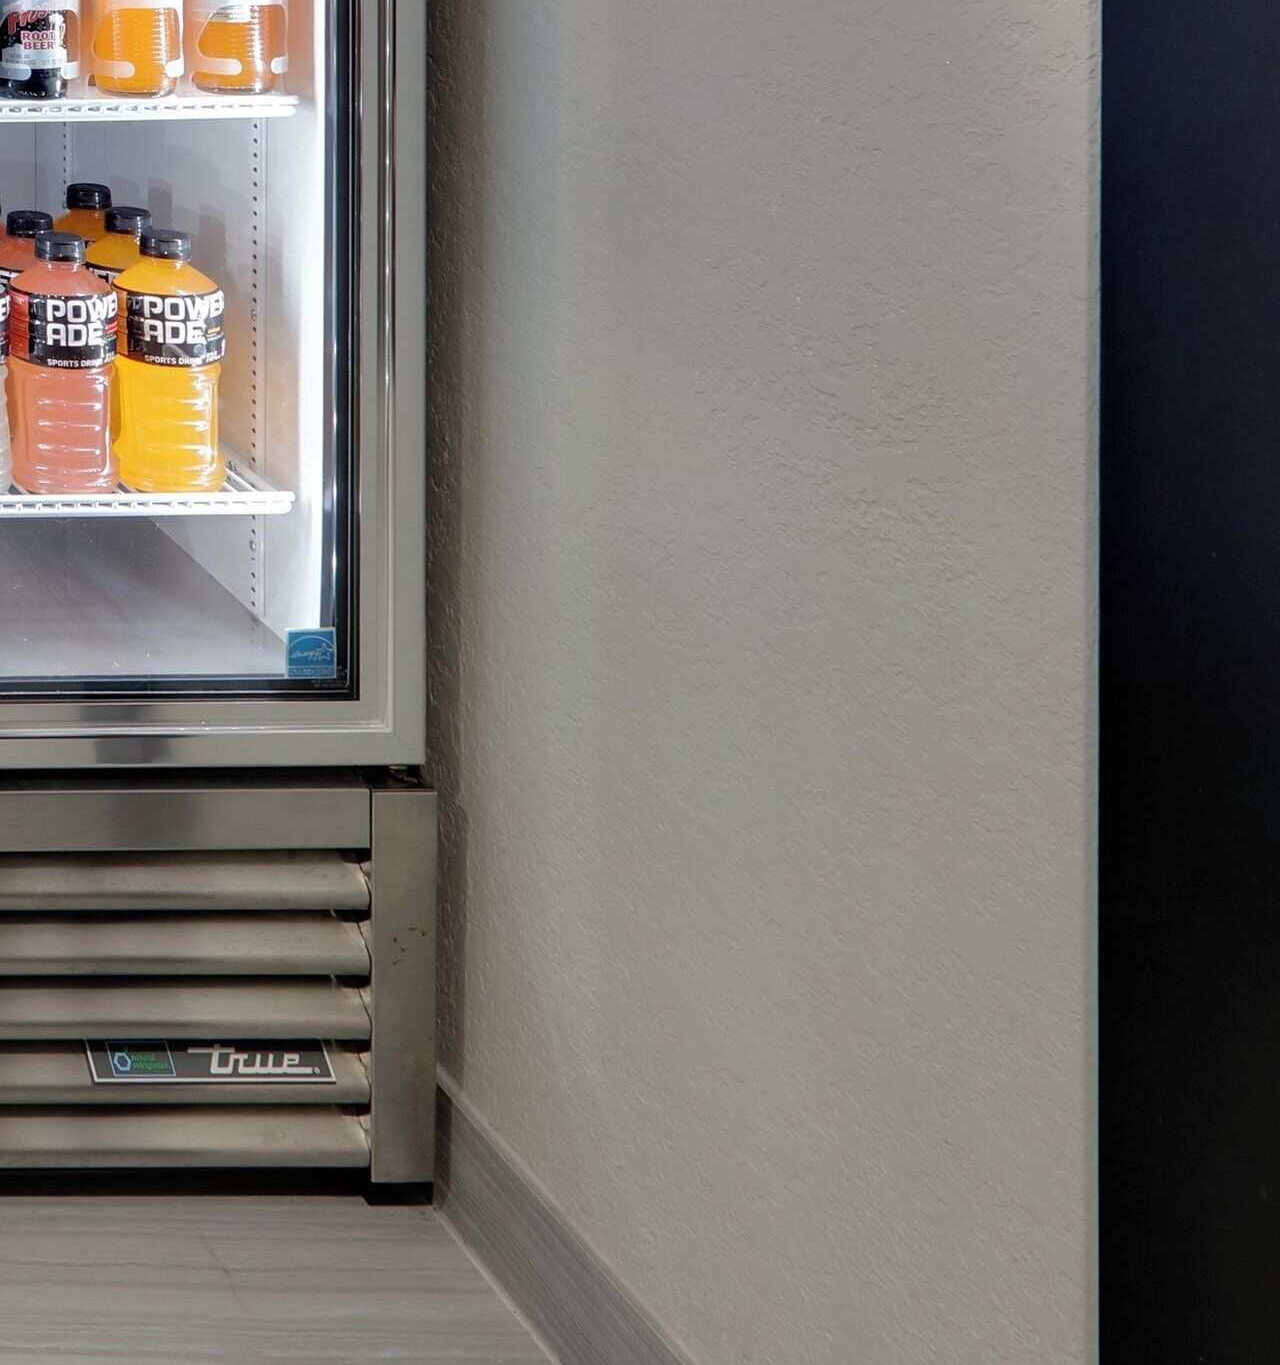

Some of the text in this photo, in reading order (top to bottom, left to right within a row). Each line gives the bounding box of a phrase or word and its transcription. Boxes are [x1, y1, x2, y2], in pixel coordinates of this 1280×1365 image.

[21, 30, 55, 41] ROOT
[23, 40, 54, 50] BEER
[46, 291, 118, 322] POWE
[46, 322, 101, 348] ADE
[144, 319, 204, 346] ADE
[47, 358, 80, 367] SPORTS
[144, 355, 176, 365] SPORTS
